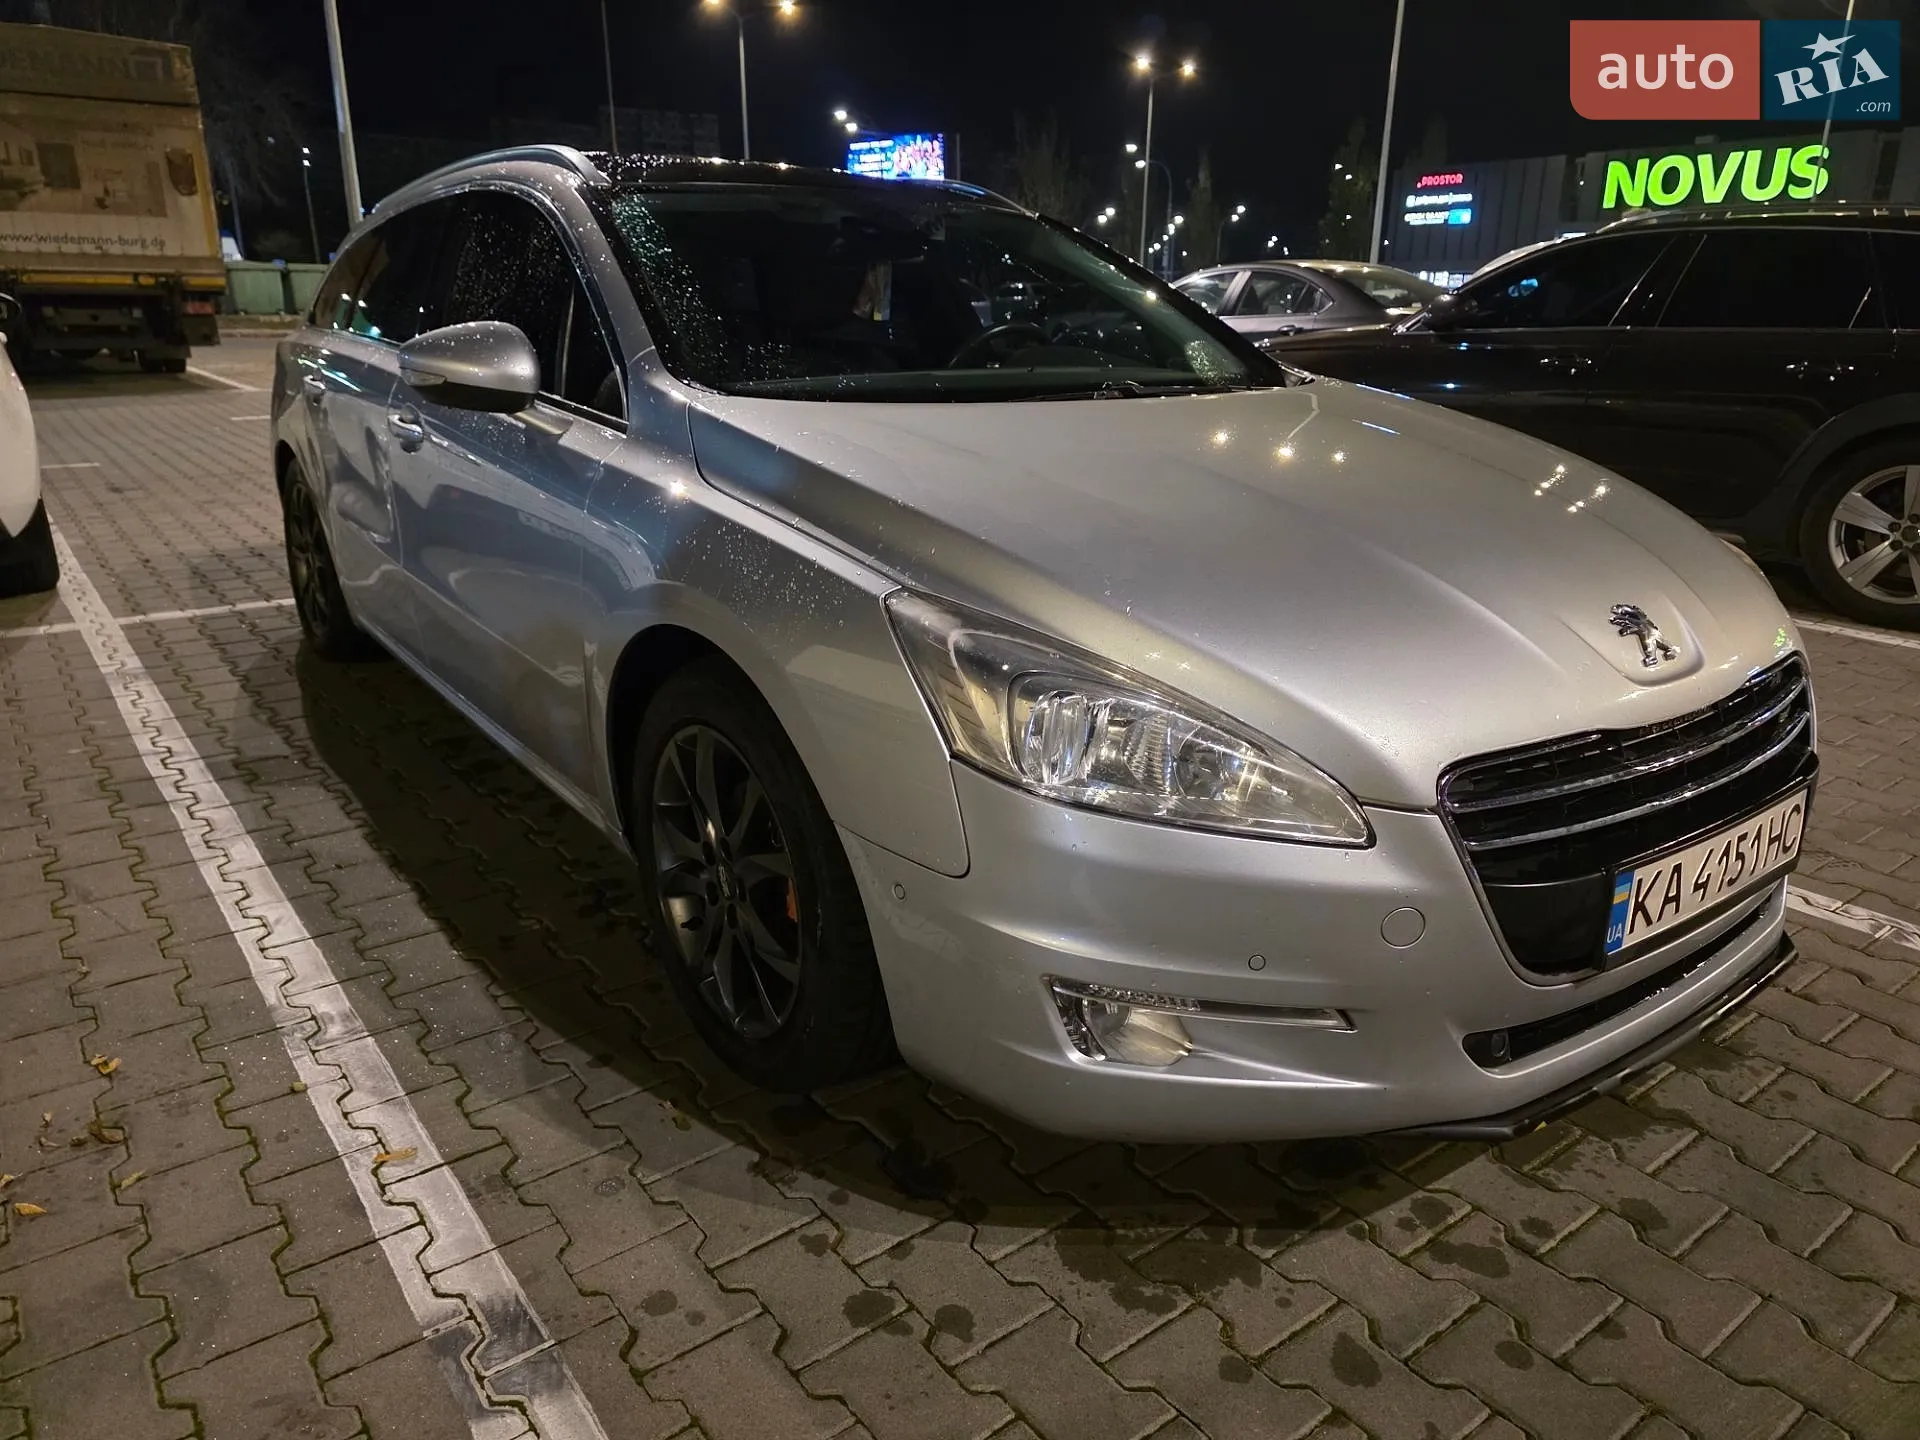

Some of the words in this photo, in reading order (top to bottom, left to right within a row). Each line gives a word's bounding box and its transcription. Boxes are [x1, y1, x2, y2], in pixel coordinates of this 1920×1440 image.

[1602, 145, 1829, 208] NOVUS
[1627, 862, 1682, 935] KA
[1607, 923, 1623, 944] UA
